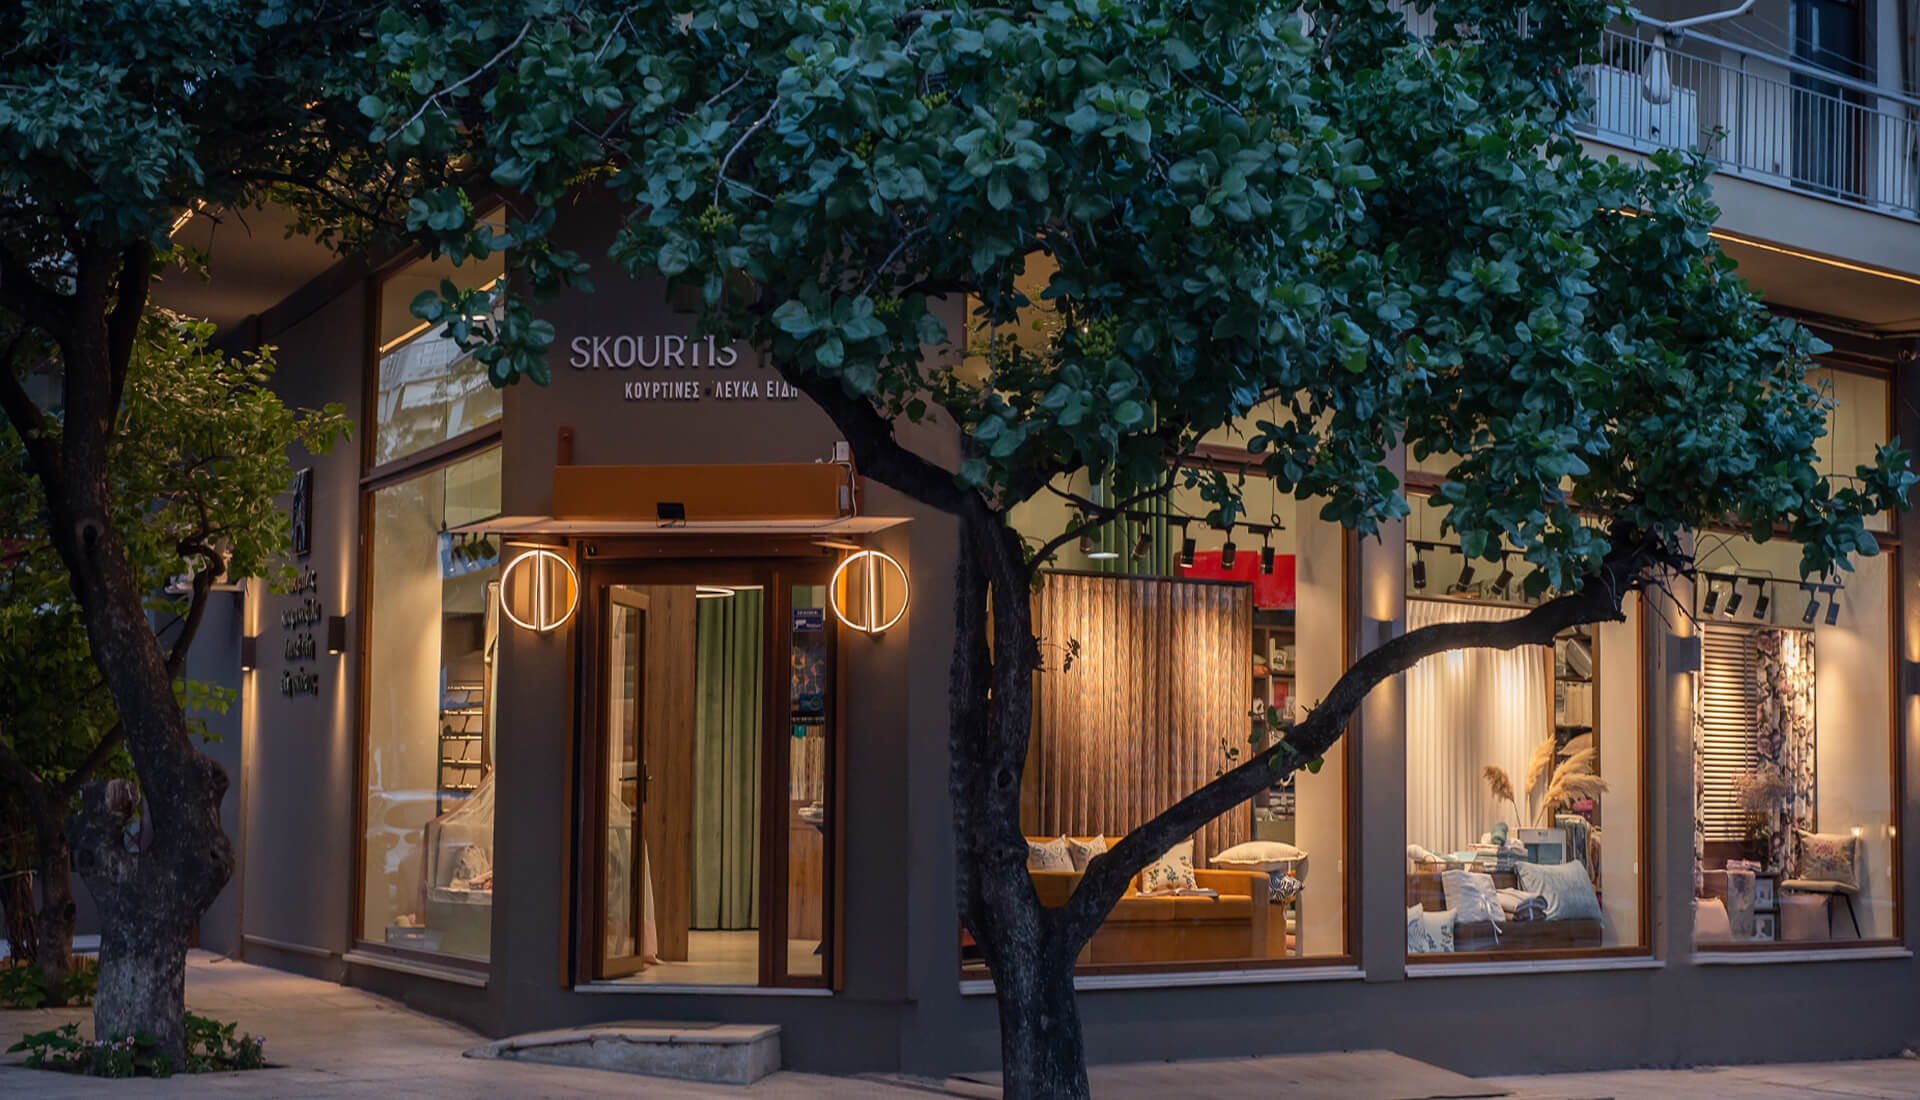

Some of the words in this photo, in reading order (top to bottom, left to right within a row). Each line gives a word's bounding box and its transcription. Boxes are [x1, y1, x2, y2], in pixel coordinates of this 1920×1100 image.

[569, 334, 738, 368] SKOURTIS
[625, 381, 700, 400] ΚΟΥΡΤΙΝΕΣ
[714, 380, 759, 399] ΛΕΥΚΑ
